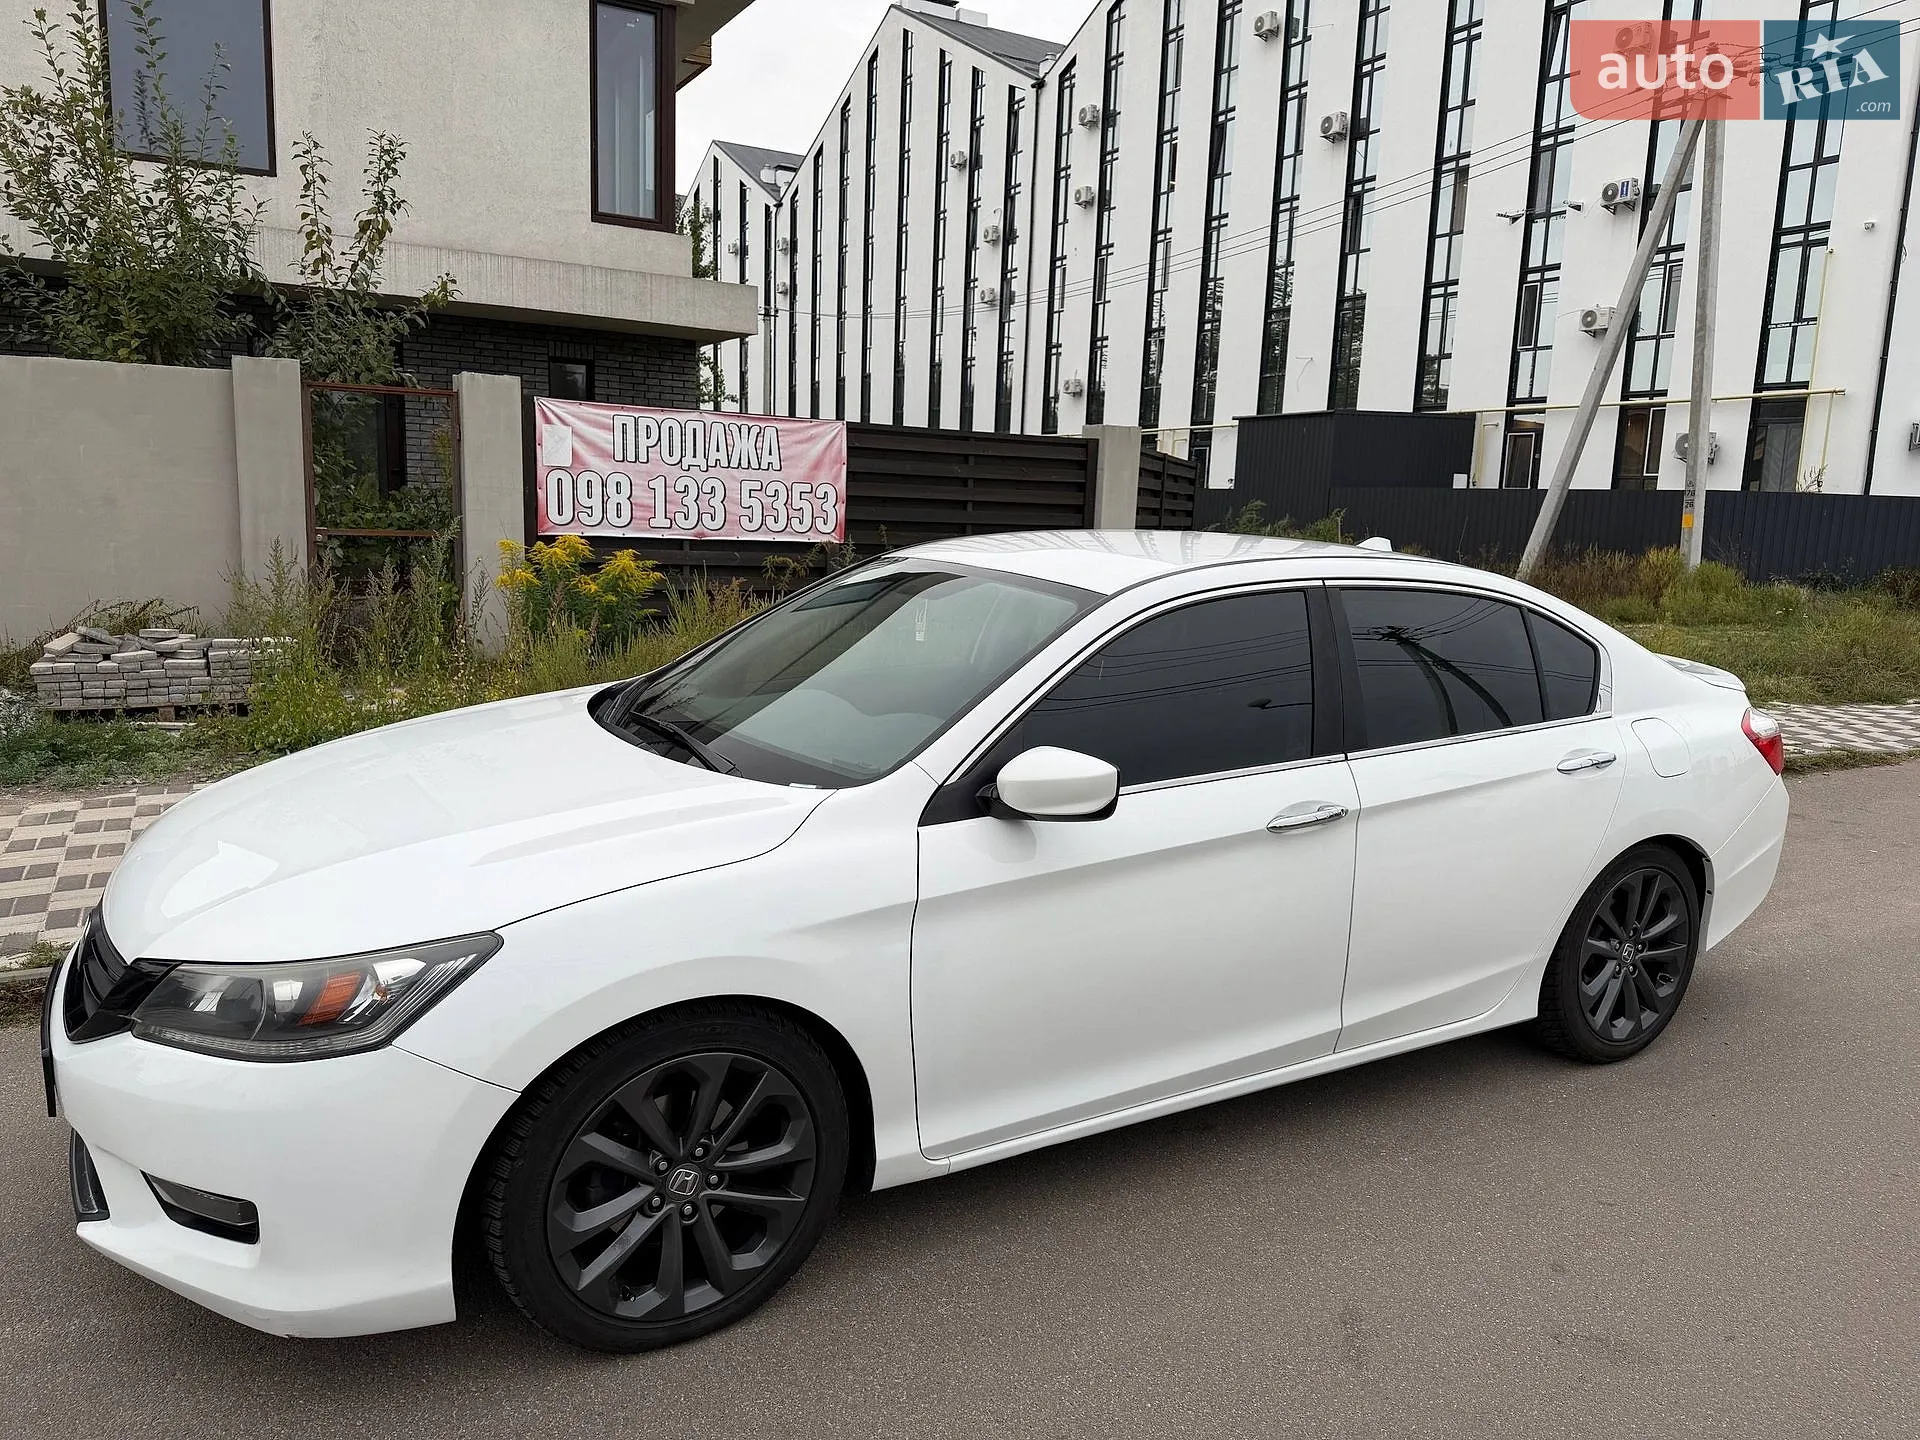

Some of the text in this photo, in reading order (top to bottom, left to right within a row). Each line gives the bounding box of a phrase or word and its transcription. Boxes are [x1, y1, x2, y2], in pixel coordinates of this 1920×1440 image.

[612, 414, 782, 471] ПРОДАЖА
[546, 468, 839, 534] 098 133 5353
